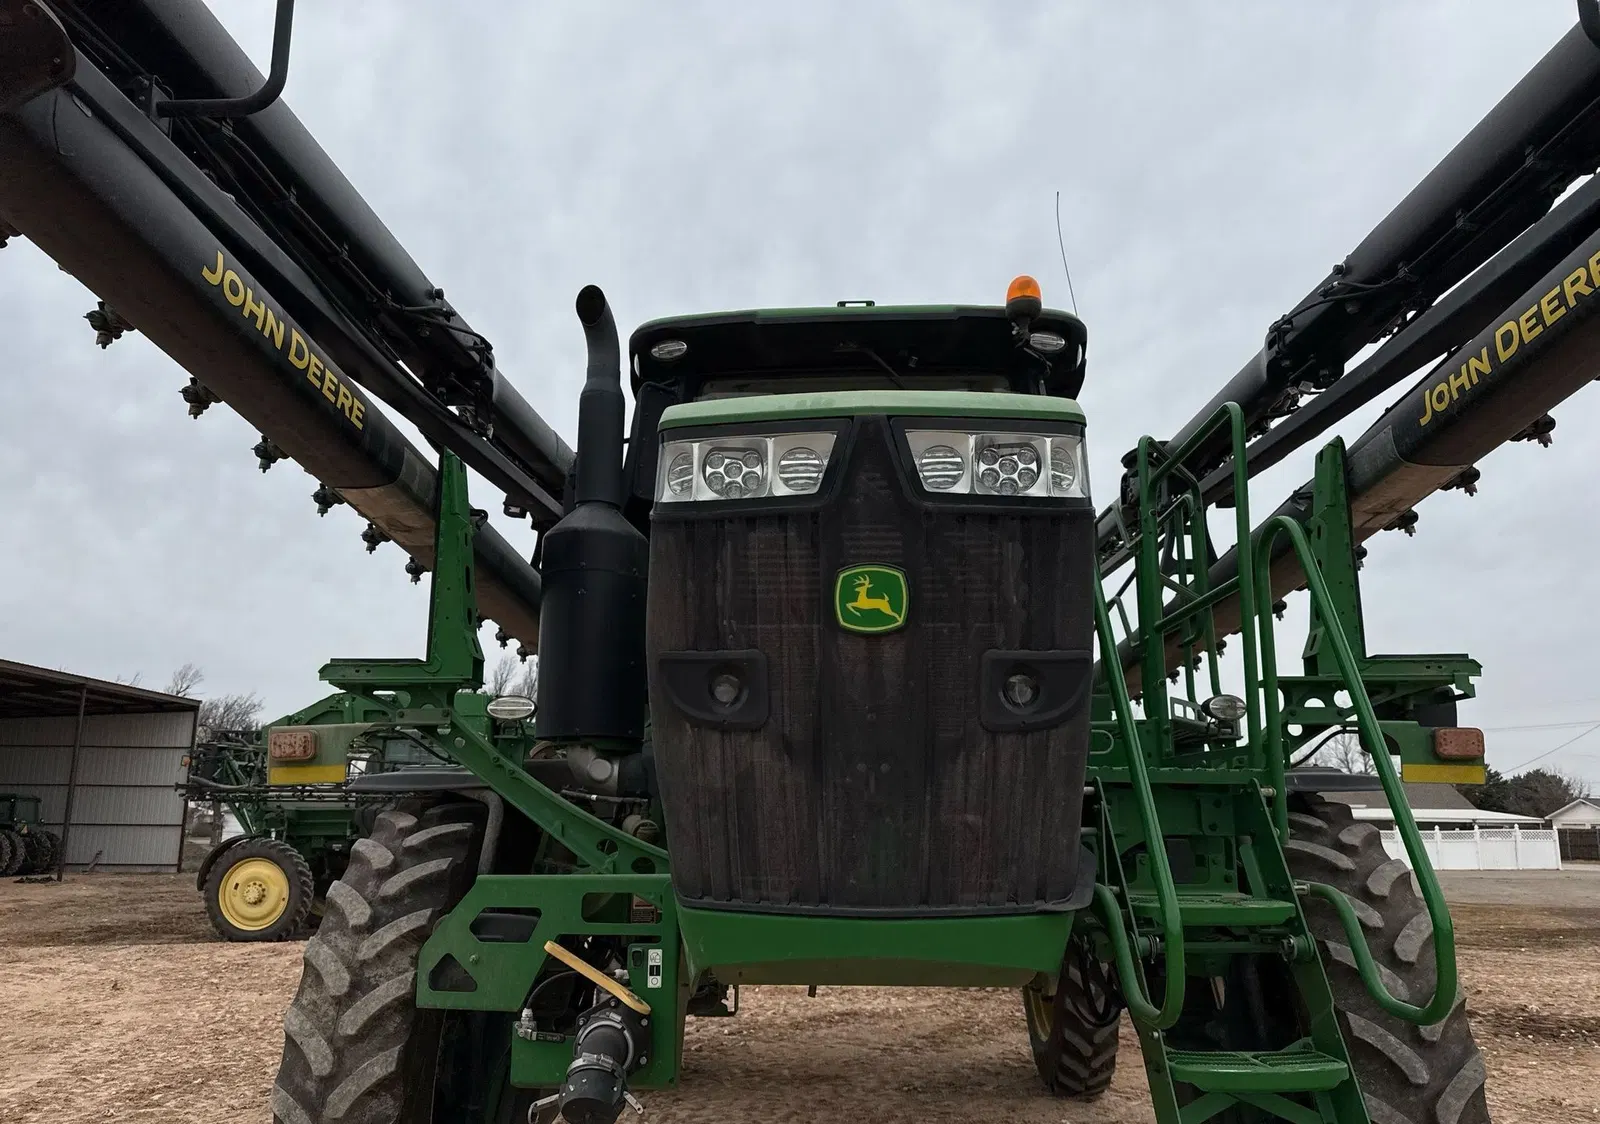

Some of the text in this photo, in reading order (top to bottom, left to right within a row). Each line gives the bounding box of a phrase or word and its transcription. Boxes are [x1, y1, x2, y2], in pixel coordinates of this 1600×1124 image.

[201, 250, 366, 430] JOHN DEERE
[1419, 346, 1492, 426] JOHN
